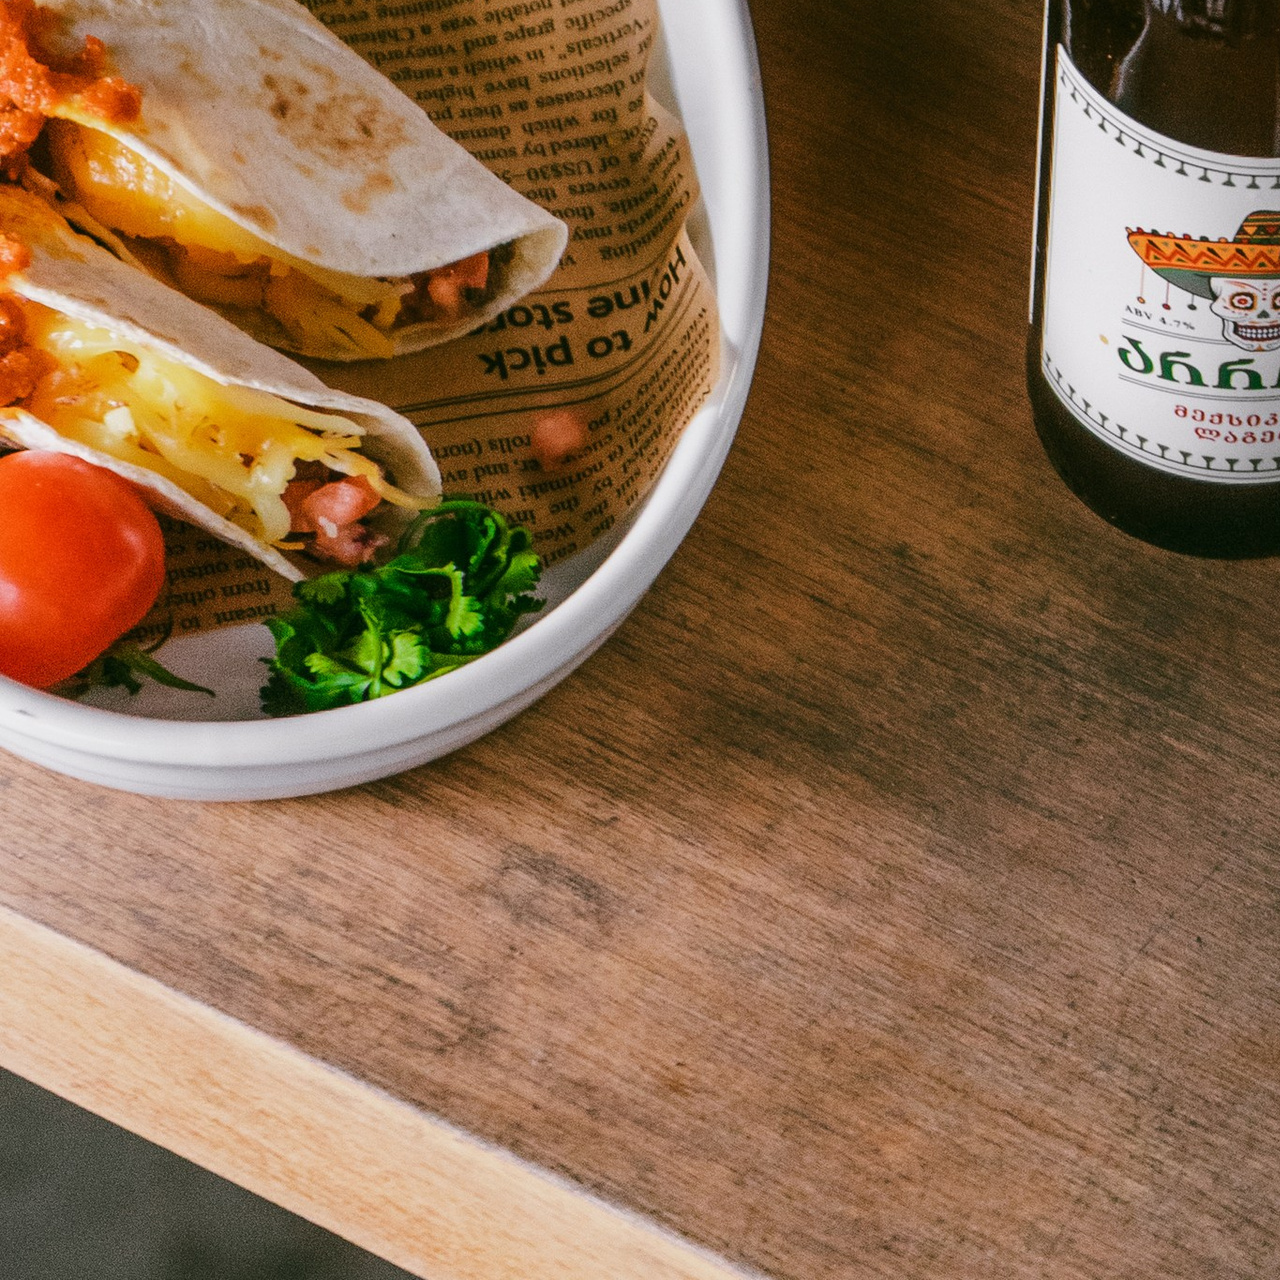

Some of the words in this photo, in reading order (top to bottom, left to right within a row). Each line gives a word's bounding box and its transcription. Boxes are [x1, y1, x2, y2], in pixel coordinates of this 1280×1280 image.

[420, 24, 432, 37] a
[440, 15, 477, 33] was
[503, 18, 556, 44] grape
[367, 44, 457, 67] vineyard,
[462, 34, 498, 57] and
[525, 48, 546, 63] in
[389, 66, 443, 82] range
[447, 65, 459, 78] a
[463, 54, 522, 78] which
[539, 50, 630, 85] selections
[415, 83, 476, 103] higher
[484, 75, 531, 96] have
[535, 79, 626, 110] decreases
[459, 104, 503, 123] their
[508, 100, 529, 115] as
[590, 106, 619, 125] for
[521, 115, 580, 137] which
[522, 141, 547, 159] by
[599, 155, 621, 175] of
[567, 177, 631, 198] covers
[572, 224, 613, 243] may
[643, 245, 687, 334] How
[1125, 304, 1153, 321] ABV
[586, 330, 633, 360] to
[477, 335, 575, 381] pick
[487, 434, 532, 454] rolls
[473, 463, 509, 483] and
[518, 461, 604, 502] norimaki
[548, 495, 581, 515] the
[222, 580, 271, 600] from
[181, 617, 200, 631] to
[216, 604, 277, 625] meant
